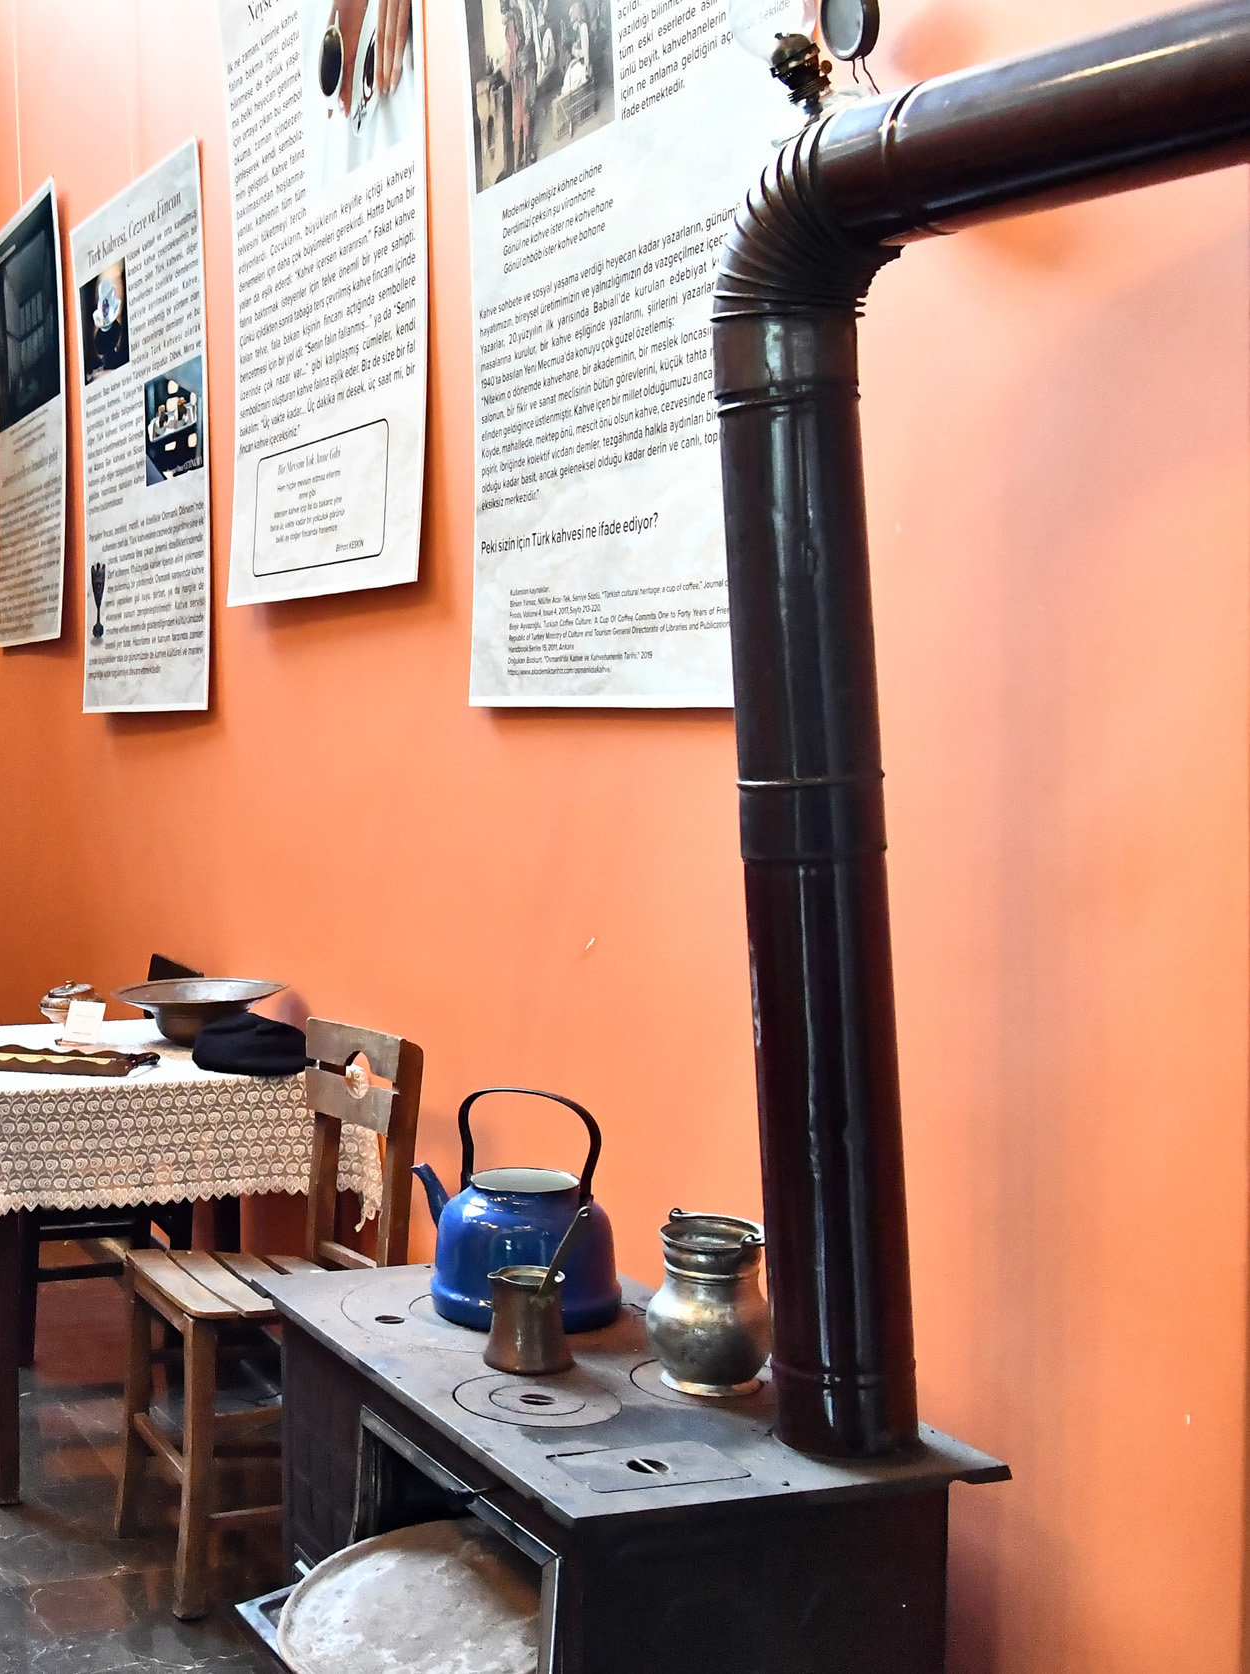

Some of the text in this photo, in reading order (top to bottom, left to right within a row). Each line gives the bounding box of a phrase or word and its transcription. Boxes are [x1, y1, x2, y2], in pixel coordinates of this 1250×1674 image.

[618, 13, 649, 43] yazıldığı
[619, 7, 696, 60] tüm eski eserlerde
[620, 12, 726, 80] ünlü beyit, kahvehanelerin
[620, 86, 634, 102] için
[636, 79, 646, 92] ne
[649, 61, 678, 84] anlama
[681, 36, 717, 70] geldiğini
[721, 31, 733, 45] açı
[621, 78, 685, 120] ifade etmektedir.
[479, 306, 497, 320] Kahve
[498, 296, 522, 313] sohbete
[523, 292, 531, 302] ve
[532, 281, 552, 299] sosyal
[554, 273, 579, 293] yaşama
[580, 259, 604, 279] verdiği
[606, 249, 636, 269] heyecan
[638, 239, 660, 256] kadar
[662, 222, 704, 250] yazarların,
[515, 305, 539, 324] bireysel
[540, 290, 580, 314] üretimimizin
[581, 288, 590, 298] ve
[591, 267, 641, 298] yalnızlığımızın
[643, 261, 652, 274] da
[654, 242, 704, 269] vazgeçilmez
[481, 339, 506, 354] Yazarlar,
[546, 318, 554, 331] ilk
[557, 306, 589, 330] yarısında
[634, 279, 665, 298] kurulan
[669, 261, 707, 285] edebiyat
[540, 339, 548, 352] bir
[551, 333, 571, 347] kahve
[574, 320, 605, 341] eşliğinde
[609, 308, 644, 330] yazılarını,
[647, 292, 678, 317] şiirlerini
[682, 281, 715, 305] yazarlar
[502, 368, 523, 383] basılan
[523, 361, 536, 375] Yeni
[575, 343, 600, 358] konuyu
[601, 336, 614, 352] çok
[615, 328, 635, 348] güzel
[636, 316, 674, 338] özetlemiş:
[506, 404, 515, 417] bir
[516, 401, 528, 413] fikir
[529, 400, 537, 410] ve
[539, 394, 556, 408] sanat
[558, 383, 591, 402] meclisinin
[593, 376, 614, 391] bütün
[616, 362, 658, 388] görevlerini,
[660, 354, 683, 371] küçük
[686, 349, 707, 364] tahta
[507, 390, 511, 399] o
[512, 379, 542, 397] dönemde
[543, 369, 580, 387] kahvehane,
[582, 363, 591, 375] bir
[593, 350, 637, 372] akademinin,
[638, 345, 648, 358] bir
[650, 334, 678, 353] meslek
[482, 432, 718, 493] olduğu kadar basit, ancak geleneksel olduğu kadar derin ve canlı, top
[527, 449, 550, 465] kolektif
[551, 446, 574, 459] vicdanı
[576, 439, 601, 454] demler,
[644, 421, 667, 437] halkla
[669, 413, 704, 433] aydınları
[481, 512, 658, 554] Peki sizin için Türk kahvesi ne ifade ediyor?
